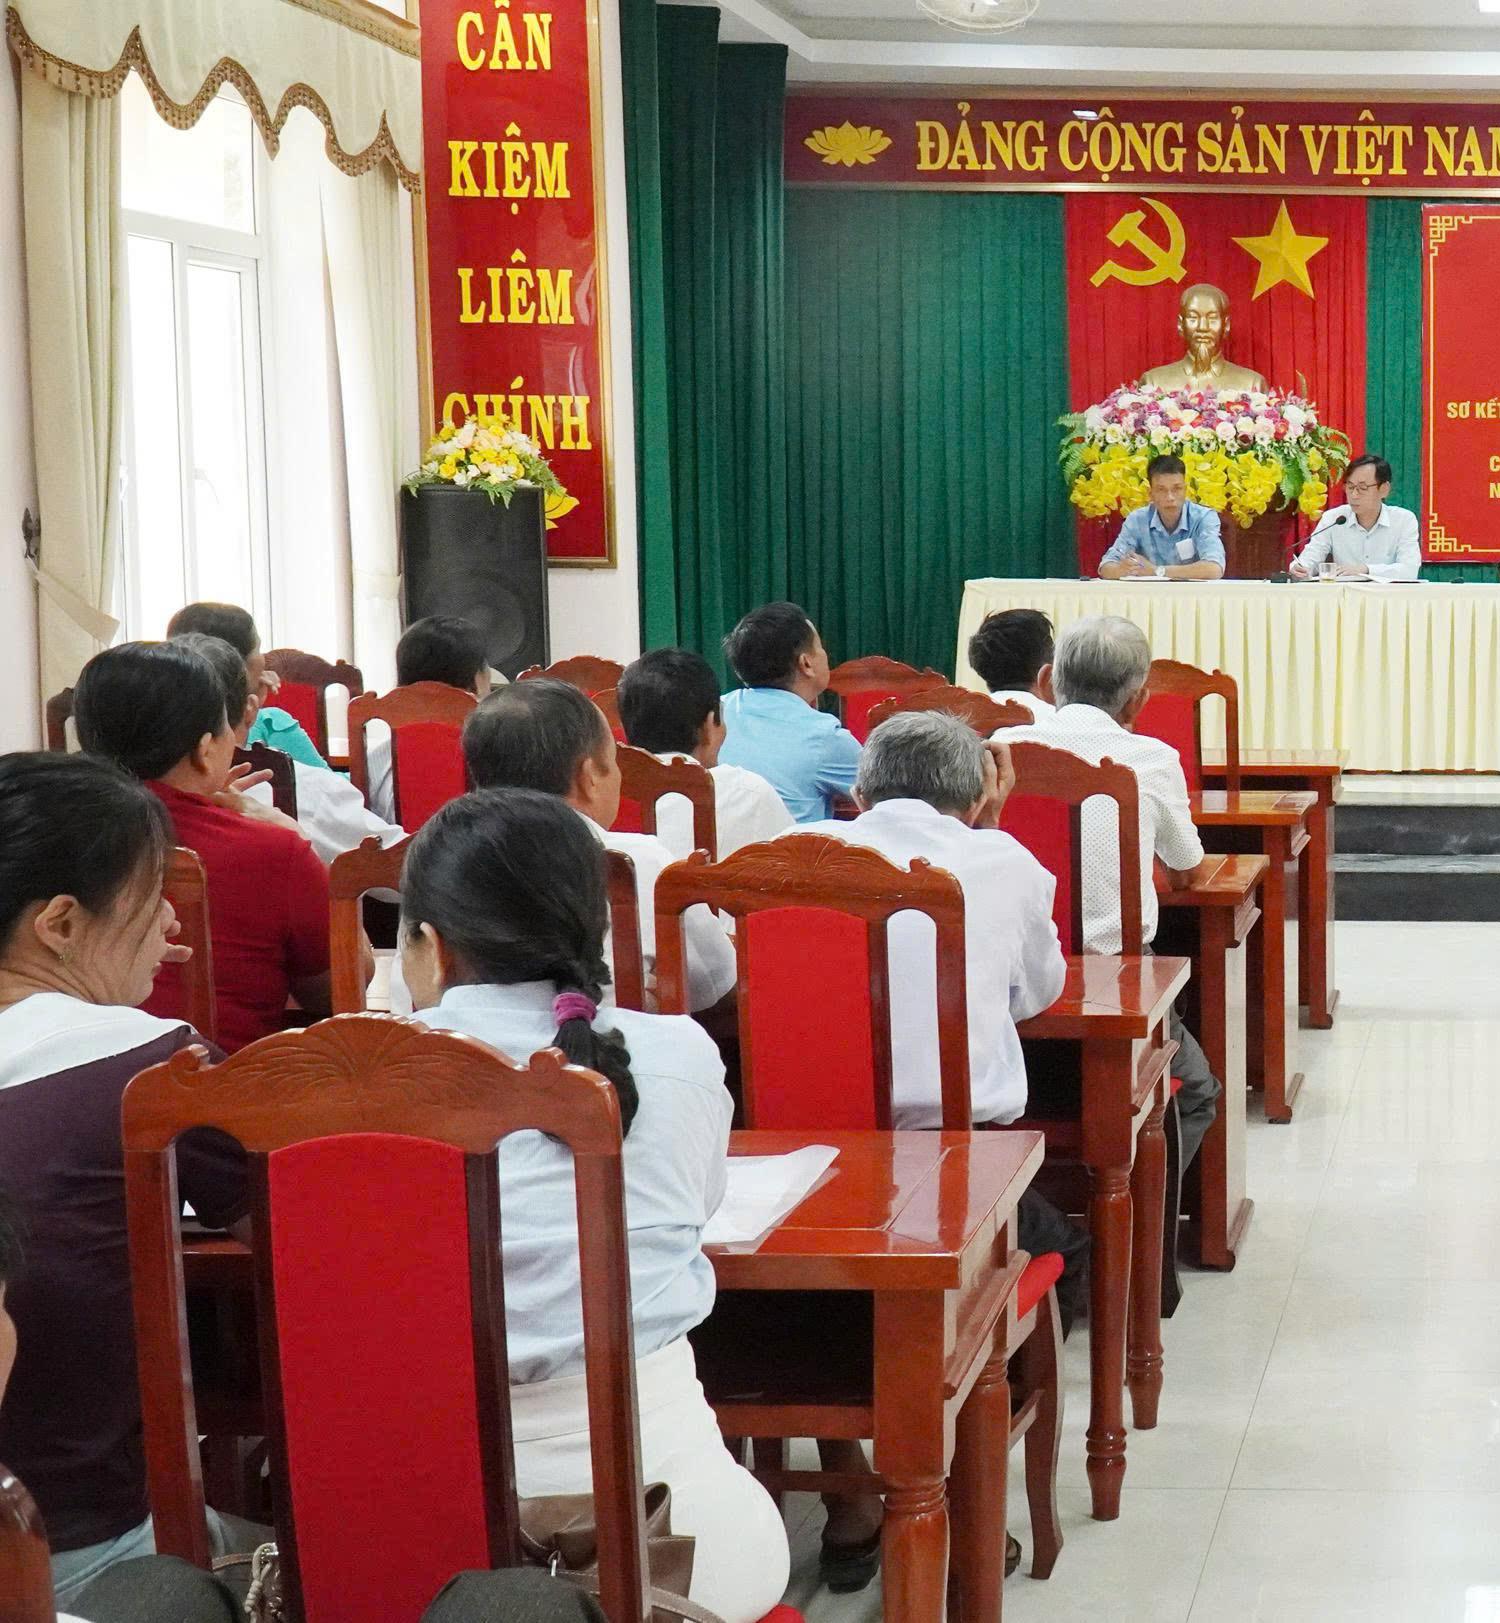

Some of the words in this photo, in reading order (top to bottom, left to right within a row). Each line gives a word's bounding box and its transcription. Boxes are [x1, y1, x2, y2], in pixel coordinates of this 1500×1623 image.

[448, 122, 570, 215] KIỆM
[916, 102, 1048, 171] ĐẢNG
[1058, 107, 1187, 182] CỘNG
[1197, 106, 1290, 175] SẢN
[1300, 110, 1413, 186] VIỆT
[457, 249, 574, 325] LIÊM
[1446, 401, 1470, 420] SƠ
